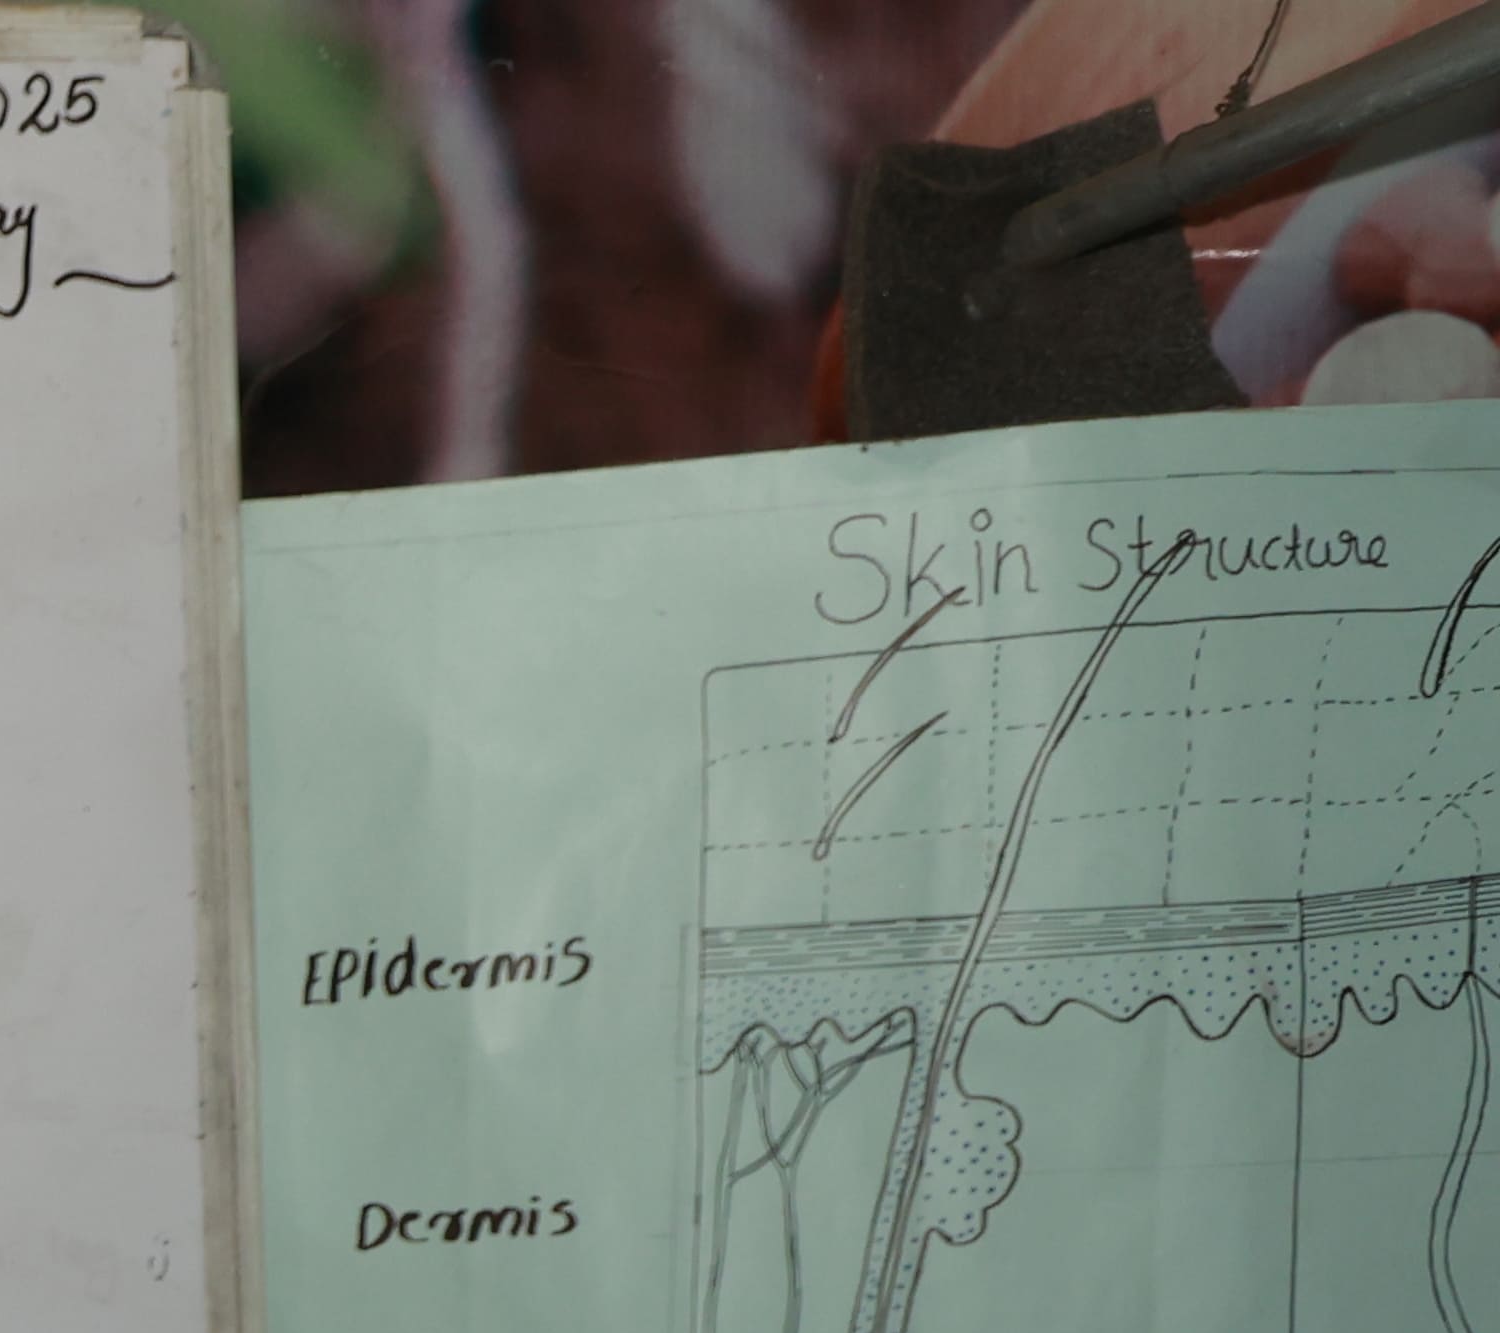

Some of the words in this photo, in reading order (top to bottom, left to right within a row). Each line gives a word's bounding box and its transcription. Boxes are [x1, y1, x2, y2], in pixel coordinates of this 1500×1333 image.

[815, 508, 1040, 624] Skin
[1077, 512, 1390, 592] Structure
[355, 1194, 579, 1252] Dermis
